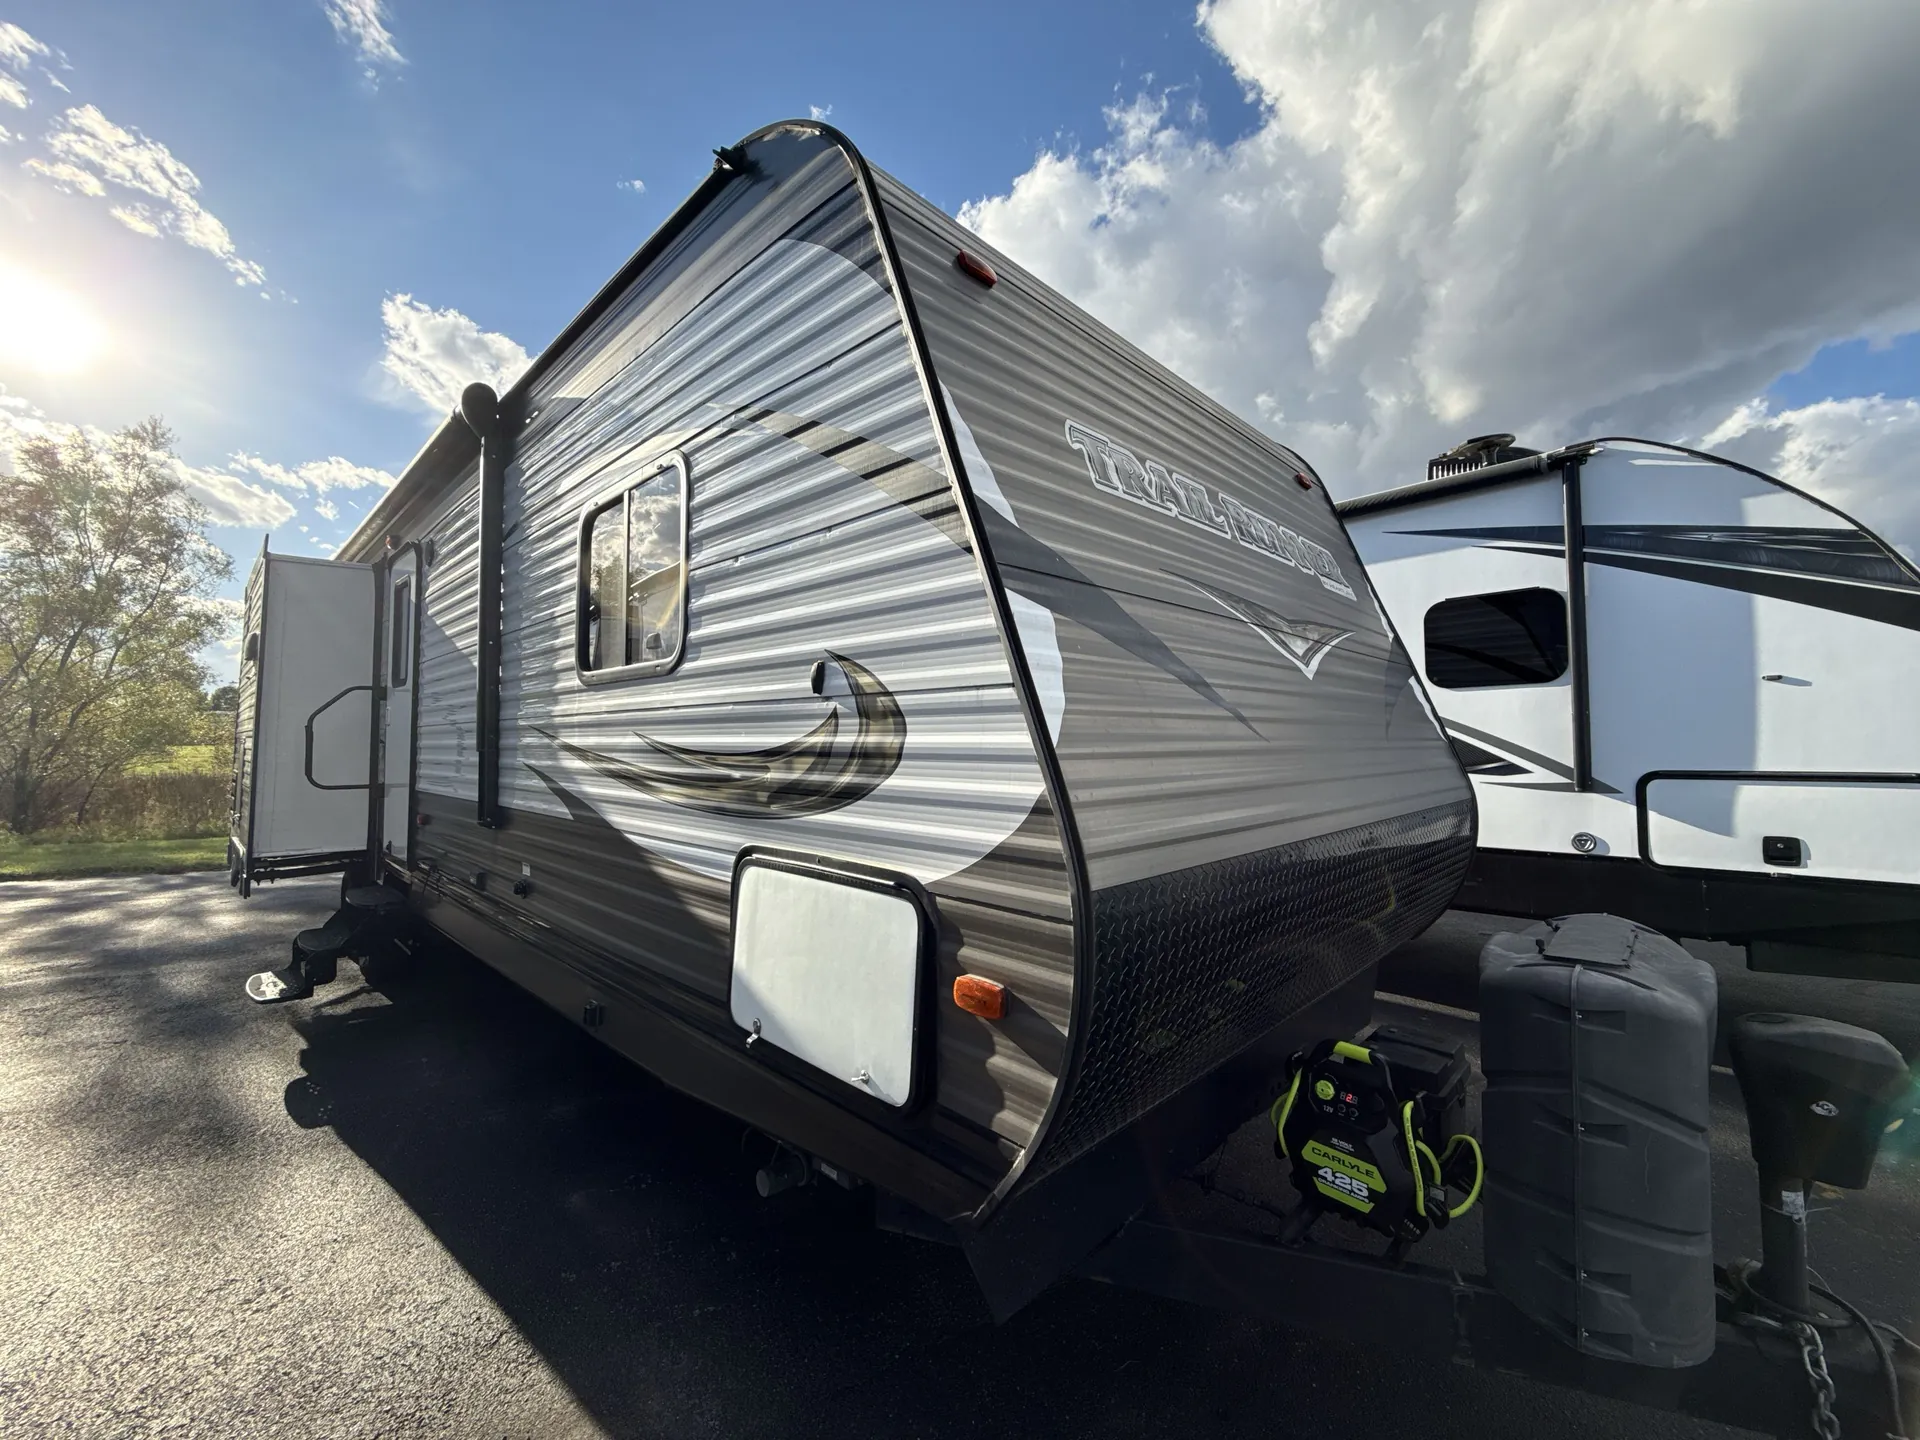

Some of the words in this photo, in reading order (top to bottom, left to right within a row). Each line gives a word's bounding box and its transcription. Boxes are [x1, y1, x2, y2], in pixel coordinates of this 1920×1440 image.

[1065, 419, 1231, 539] TRAIL
[1312, 1147, 1376, 1180] CARLYLE
[1318, 1167, 1369, 1197] 425
